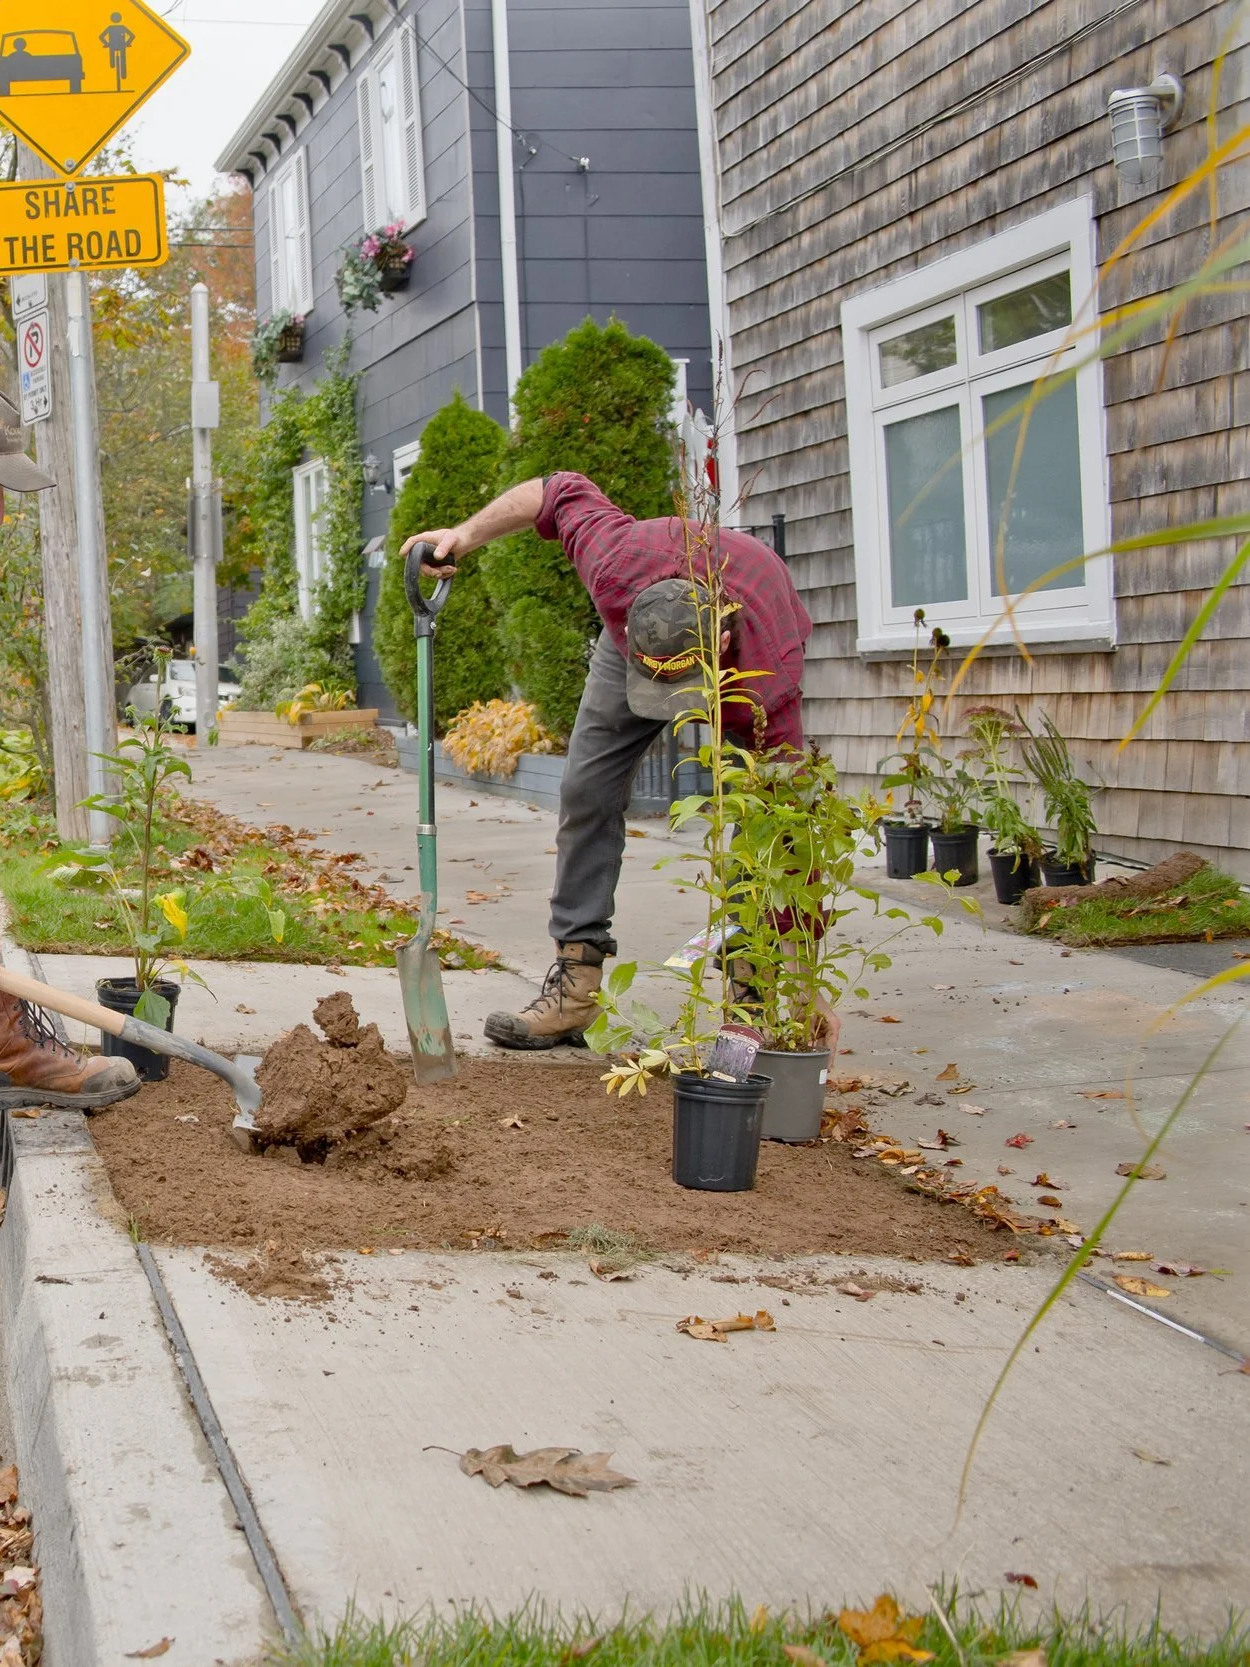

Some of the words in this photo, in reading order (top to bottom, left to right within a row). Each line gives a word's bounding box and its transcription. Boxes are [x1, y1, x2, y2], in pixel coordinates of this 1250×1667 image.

[25, 186, 116, 220] SHARE
[3, 234, 56, 265] THE
[67, 229, 142, 262] ROAD
[663, 656, 695, 671] MORGAN
